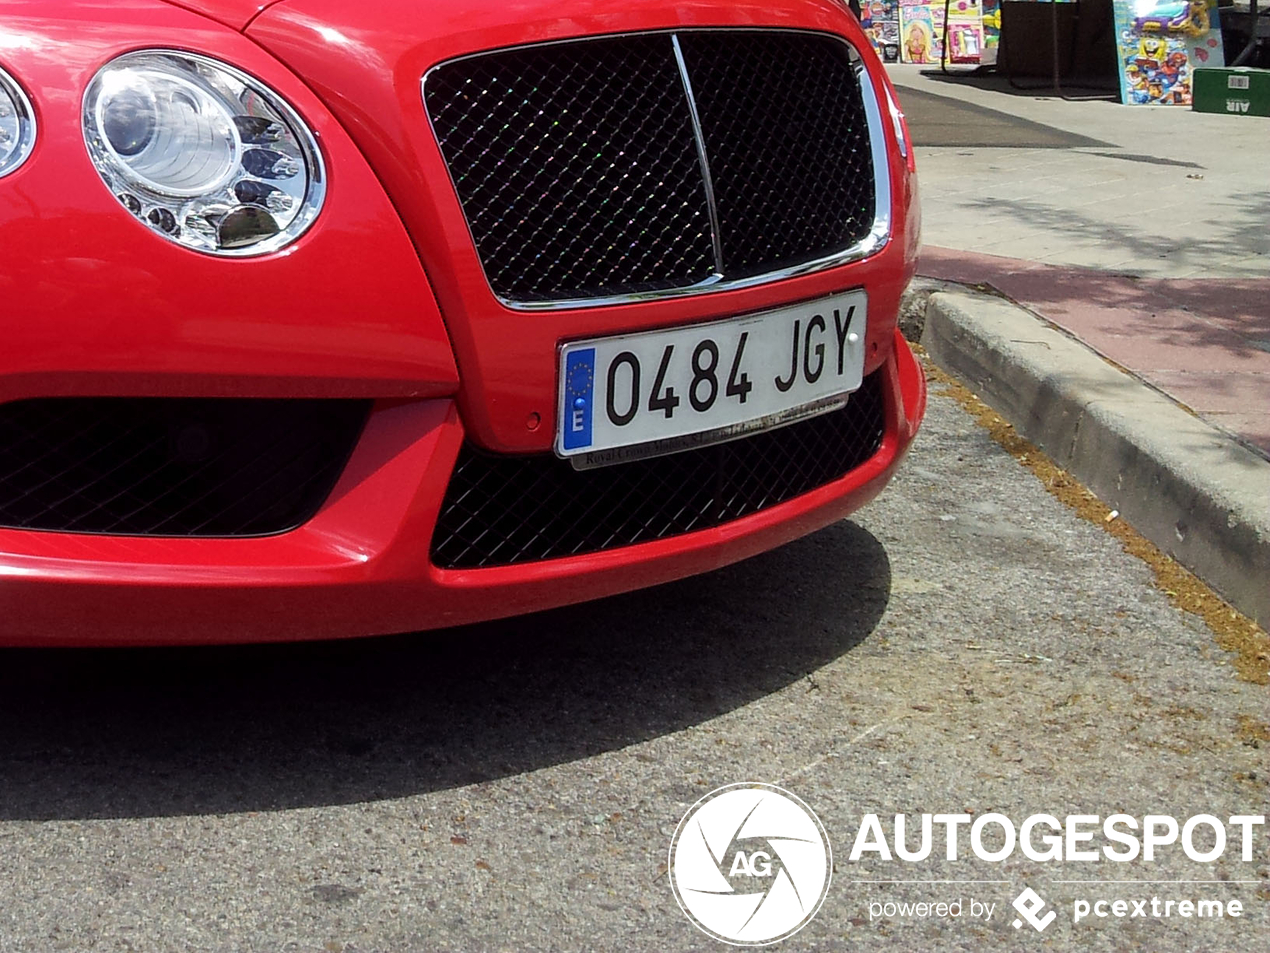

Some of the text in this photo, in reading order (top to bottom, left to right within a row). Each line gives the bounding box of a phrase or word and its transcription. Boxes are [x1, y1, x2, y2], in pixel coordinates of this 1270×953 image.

[1226, 100, 1250, 112] AIR
[606, 305, 856, 427] 0484 JGY
[571, 410, 584, 432] E
